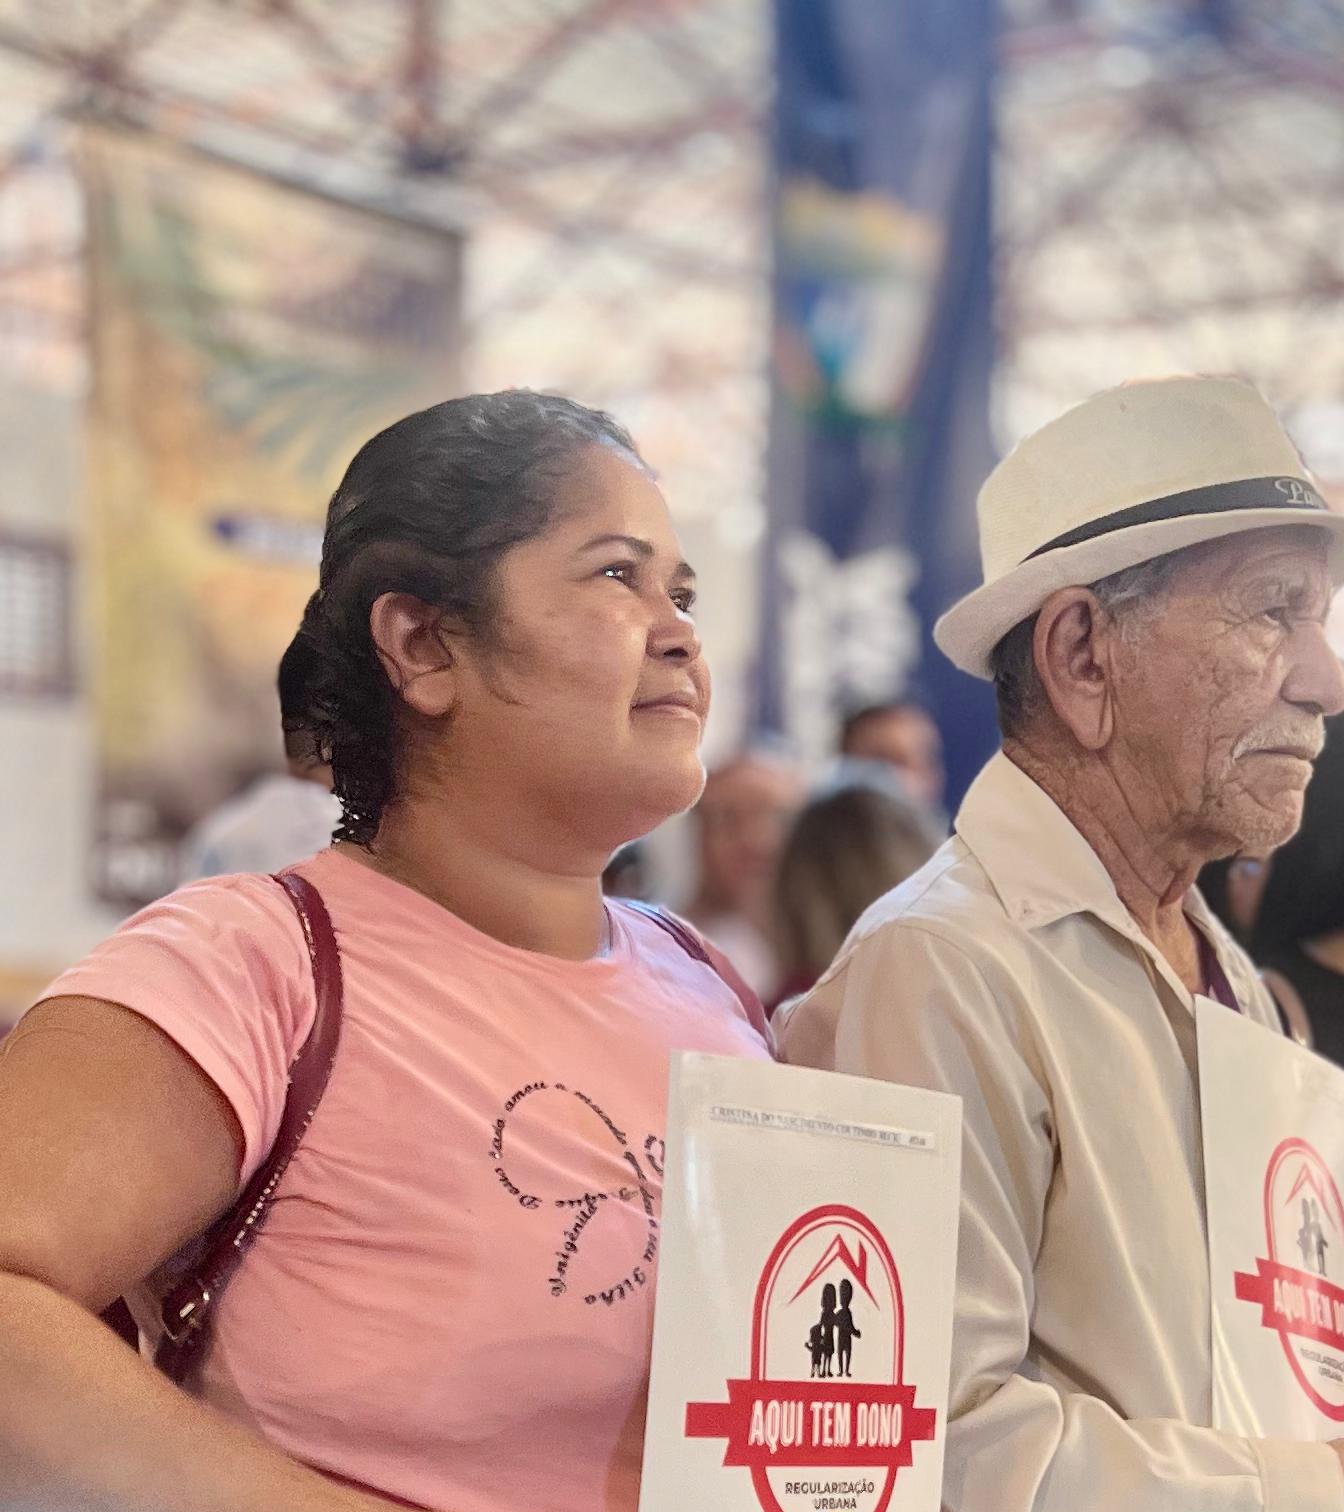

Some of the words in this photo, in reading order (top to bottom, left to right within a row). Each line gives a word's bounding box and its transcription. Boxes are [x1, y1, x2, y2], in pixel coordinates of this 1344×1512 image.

[504, 1080, 548, 1112] amou
[1273, 1277, 1306, 1324] AQUI
[1306, 1288, 1333, 1331] TEM
[747, 1399, 804, 1454] AQUI
[809, 1401, 851, 1447] TEM
[856, 1402, 903, 1448] DONO
[784, 1478, 875, 1496] REGULARIZAÇÃO
[813, 1497, 857, 1510] URBANA
